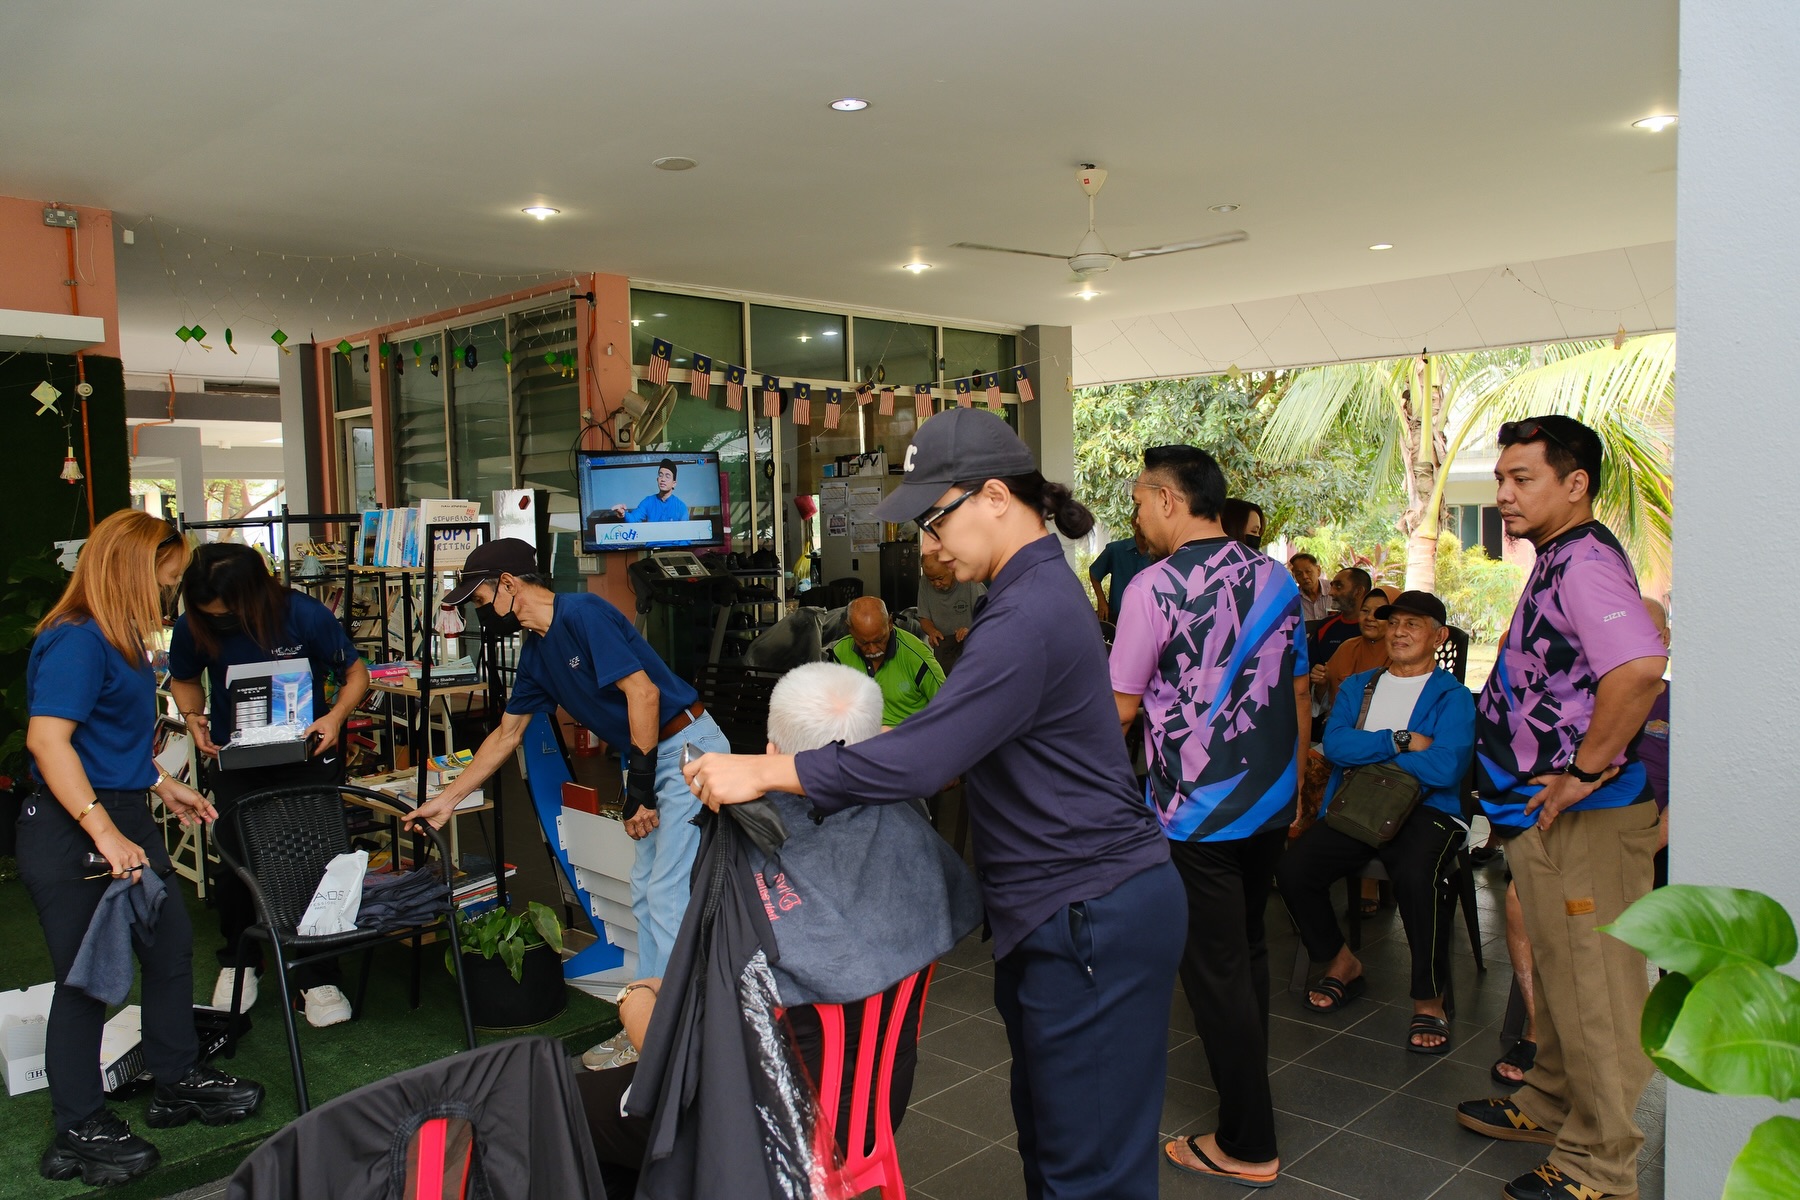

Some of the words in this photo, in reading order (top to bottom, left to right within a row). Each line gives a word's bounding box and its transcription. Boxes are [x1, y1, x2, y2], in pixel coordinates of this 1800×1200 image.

[903, 444, 918, 472] C
[434, 528, 471, 541] COPY
[434, 542, 471, 552] RITING
